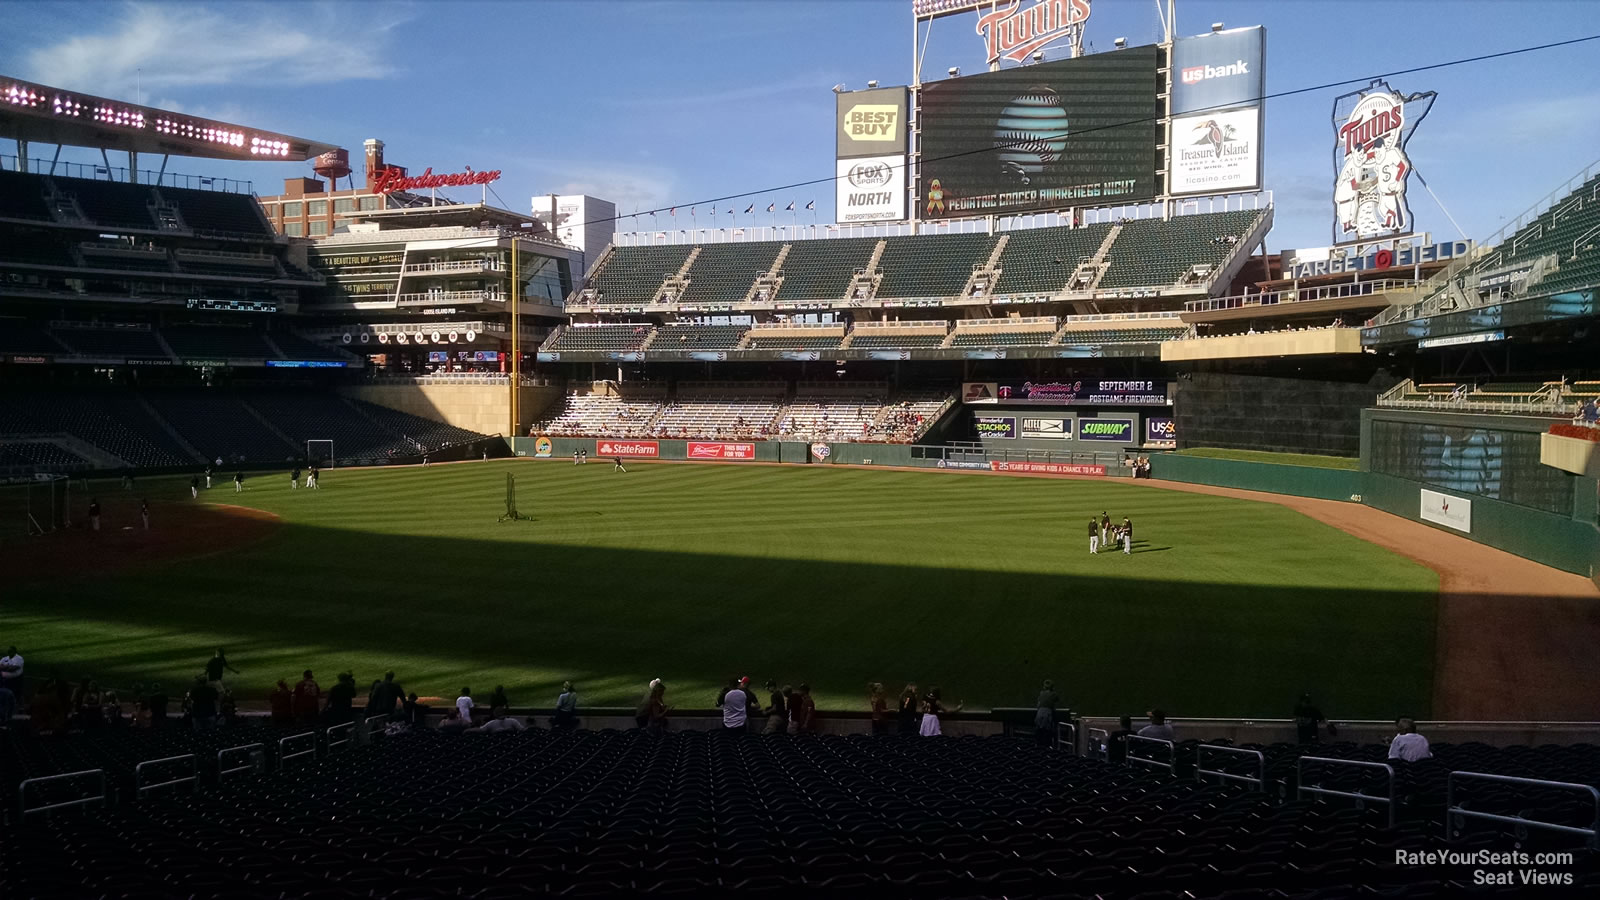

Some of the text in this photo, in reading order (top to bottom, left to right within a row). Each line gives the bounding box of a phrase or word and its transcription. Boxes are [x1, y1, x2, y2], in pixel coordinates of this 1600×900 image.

[976, 0, 1091, 64] Twins
[851, 112, 896, 123] BEST
[852, 124, 892, 135] BUY
[1340, 105, 1401, 157] Twins
[1180, 148, 1214, 161] Treasure
[1223, 142, 1249, 156] Island
[856, 165, 883, 179] FOX
[368, 165, 501, 195] Budweiser
[1186, 174, 1240, 184] ticasino.com
[848, 192, 892, 206] NORTH
[949, 180, 1136, 211] PEDIATRIC CANCER AWARENESS NIGHT
[333, 257, 360, 265] BEAUTIFUL
[360, 256, 370, 264] DAY
[1289, 239, 1469, 279] TARGET FIELD
[353, 284, 371, 293] TWINS
[1099, 381, 1152, 391] SEPTEMBER 2
[1089, 395, 1164, 404] POSTGAME FIREWORKS
[1081, 423, 1129, 435] SUBWAY
[999, 462, 1008, 471] 25
[1009, 463, 1024, 471] YEARS
[1047, 464, 1058, 472] KIDS
[1063, 465, 1081, 473] CHANCE
